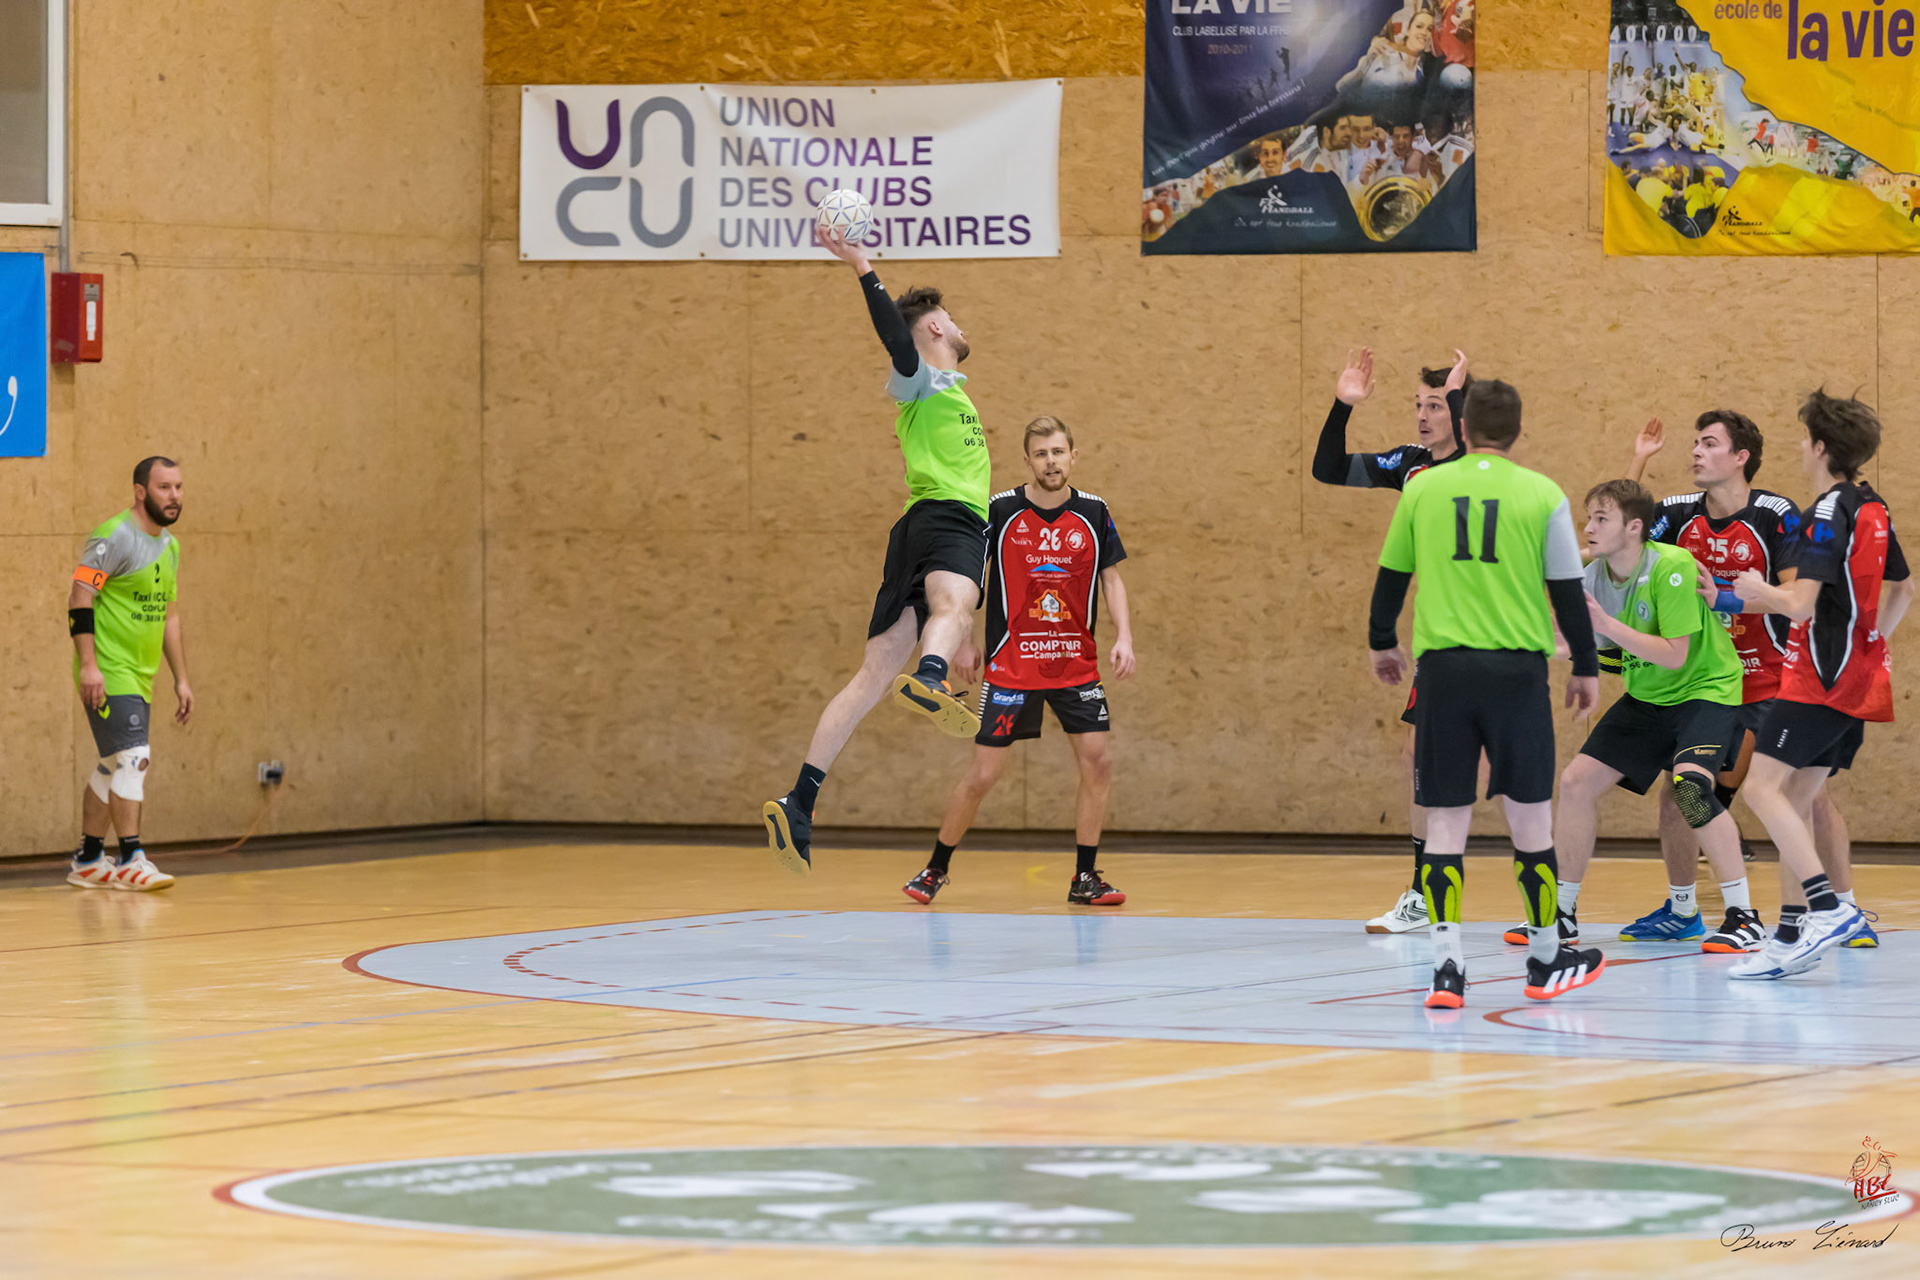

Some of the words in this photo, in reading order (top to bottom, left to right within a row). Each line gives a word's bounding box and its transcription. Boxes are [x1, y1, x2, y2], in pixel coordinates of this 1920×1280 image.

[1763, 0, 1783, 19] de
[1172, 25, 1193, 36] CLUB
[1239, 26, 1256, 36] PAR
[1257, 26, 1268, 35] LA
[1787, 0, 1828, 61] la
[1841, 0, 1915, 58] vie
[720, 97, 835, 127] UNION
[721, 136, 933, 167] NATIONALE
[720, 177, 793, 208] DES
[720, 214, 1031, 249] UNIVSITAIRES
[964, 438, 976, 446] 06
[1038, 527, 1062, 552] 26
[1452, 496, 1499, 564] 11
[1026, 554, 1042, 565] Guy
[1043, 555, 1073, 565] Hoquet
[1706, 537, 1728, 564] 25
[92, 572, 103, 587] C
